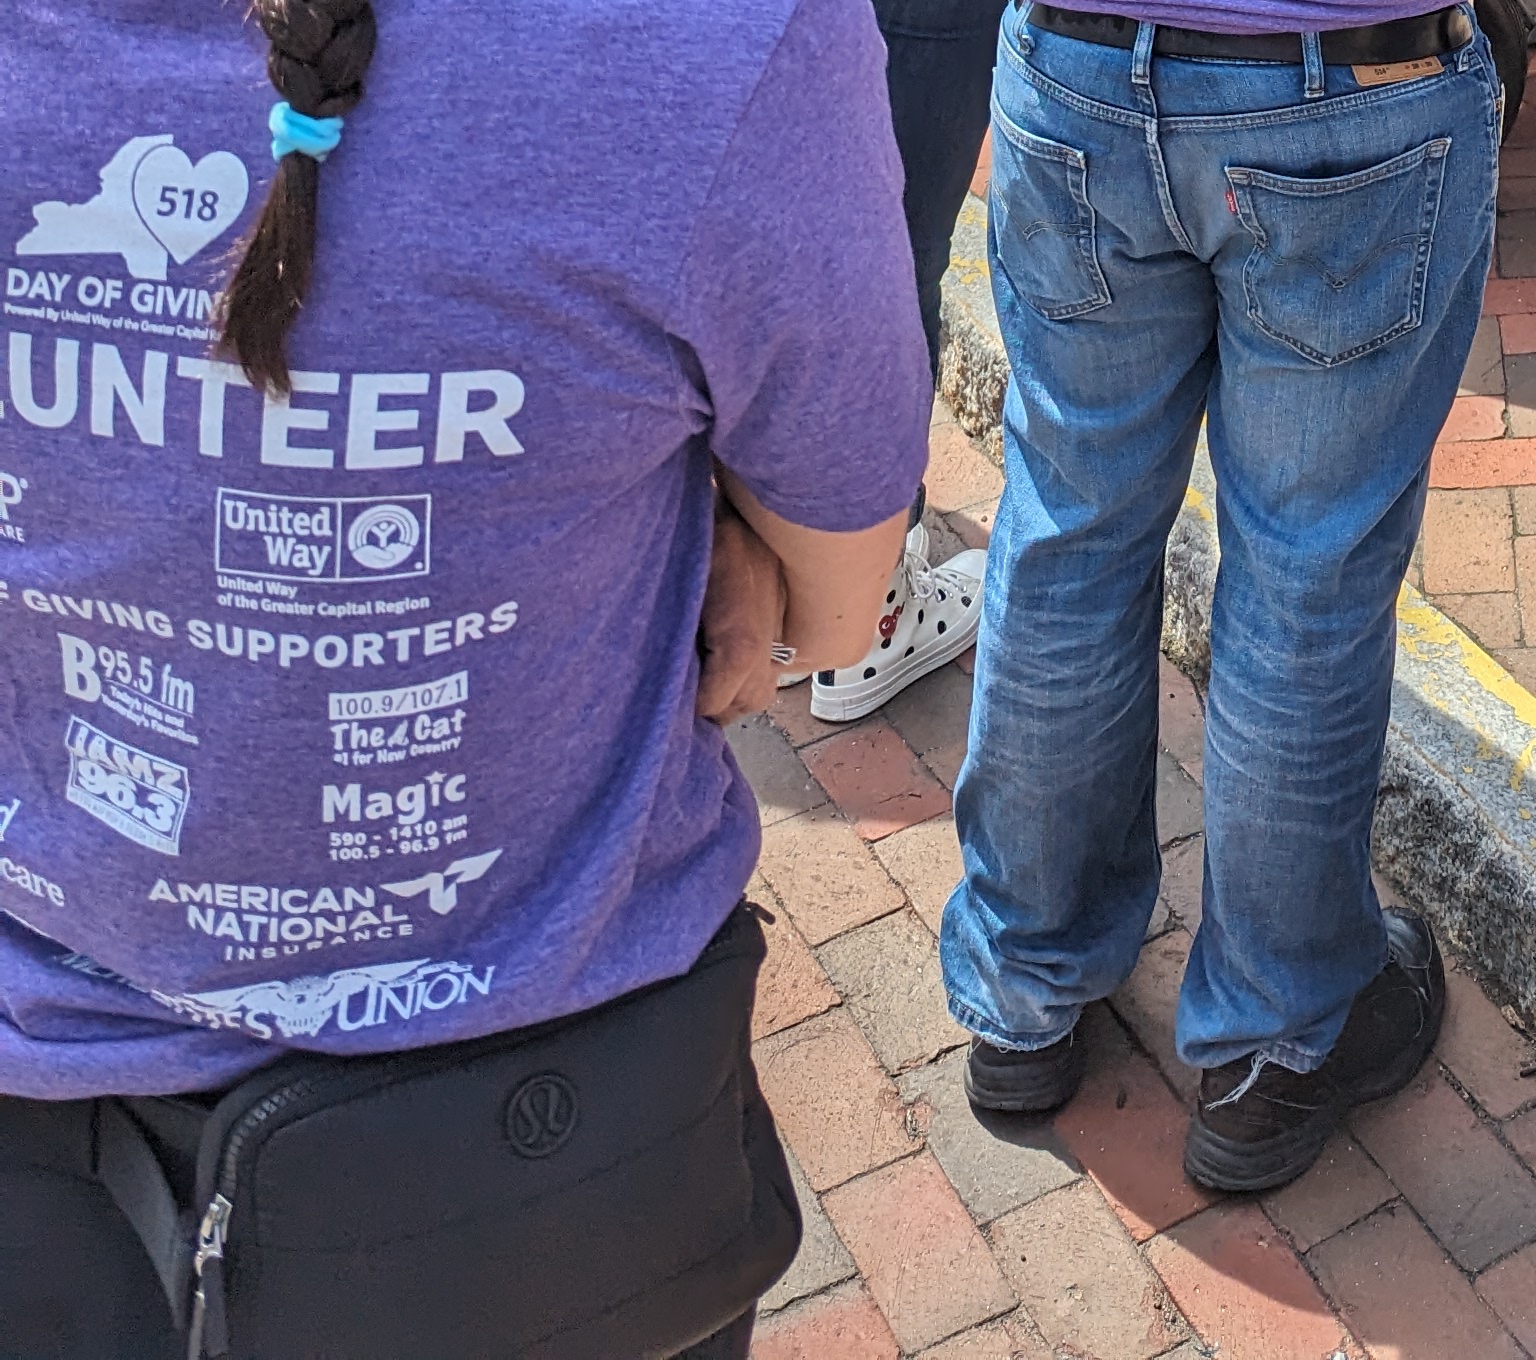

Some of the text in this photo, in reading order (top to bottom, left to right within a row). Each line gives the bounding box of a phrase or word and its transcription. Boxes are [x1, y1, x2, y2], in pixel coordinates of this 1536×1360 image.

[156, 184, 219, 221] 518
[7, 268, 124, 308] DAY OF
[224, 499, 331, 537] United
[265, 536, 331, 575] Way
[217, 575, 297, 599] United Way
[218, 593, 430, 619] of the Greater Capital Region
[21, 588, 519, 670] GIVING SUPPORTERS
[337, 674, 463, 717] 100.9/107.1
[330, 708, 466, 751] The Cat
[72, 727, 186, 799] JAMZ
[79, 762, 178, 833] 96.3
[322, 771, 466, 825] Magic
[329, 820, 437, 847] 590 1410
[329, 829, 468, 861] 100.5 96.9 fm
[149, 878, 376, 915] AMERICAN
[187, 904, 408, 943] NATIONAL
[225, 925, 413, 962] INSURANCE
[337, 964, 496, 1033] UNION
